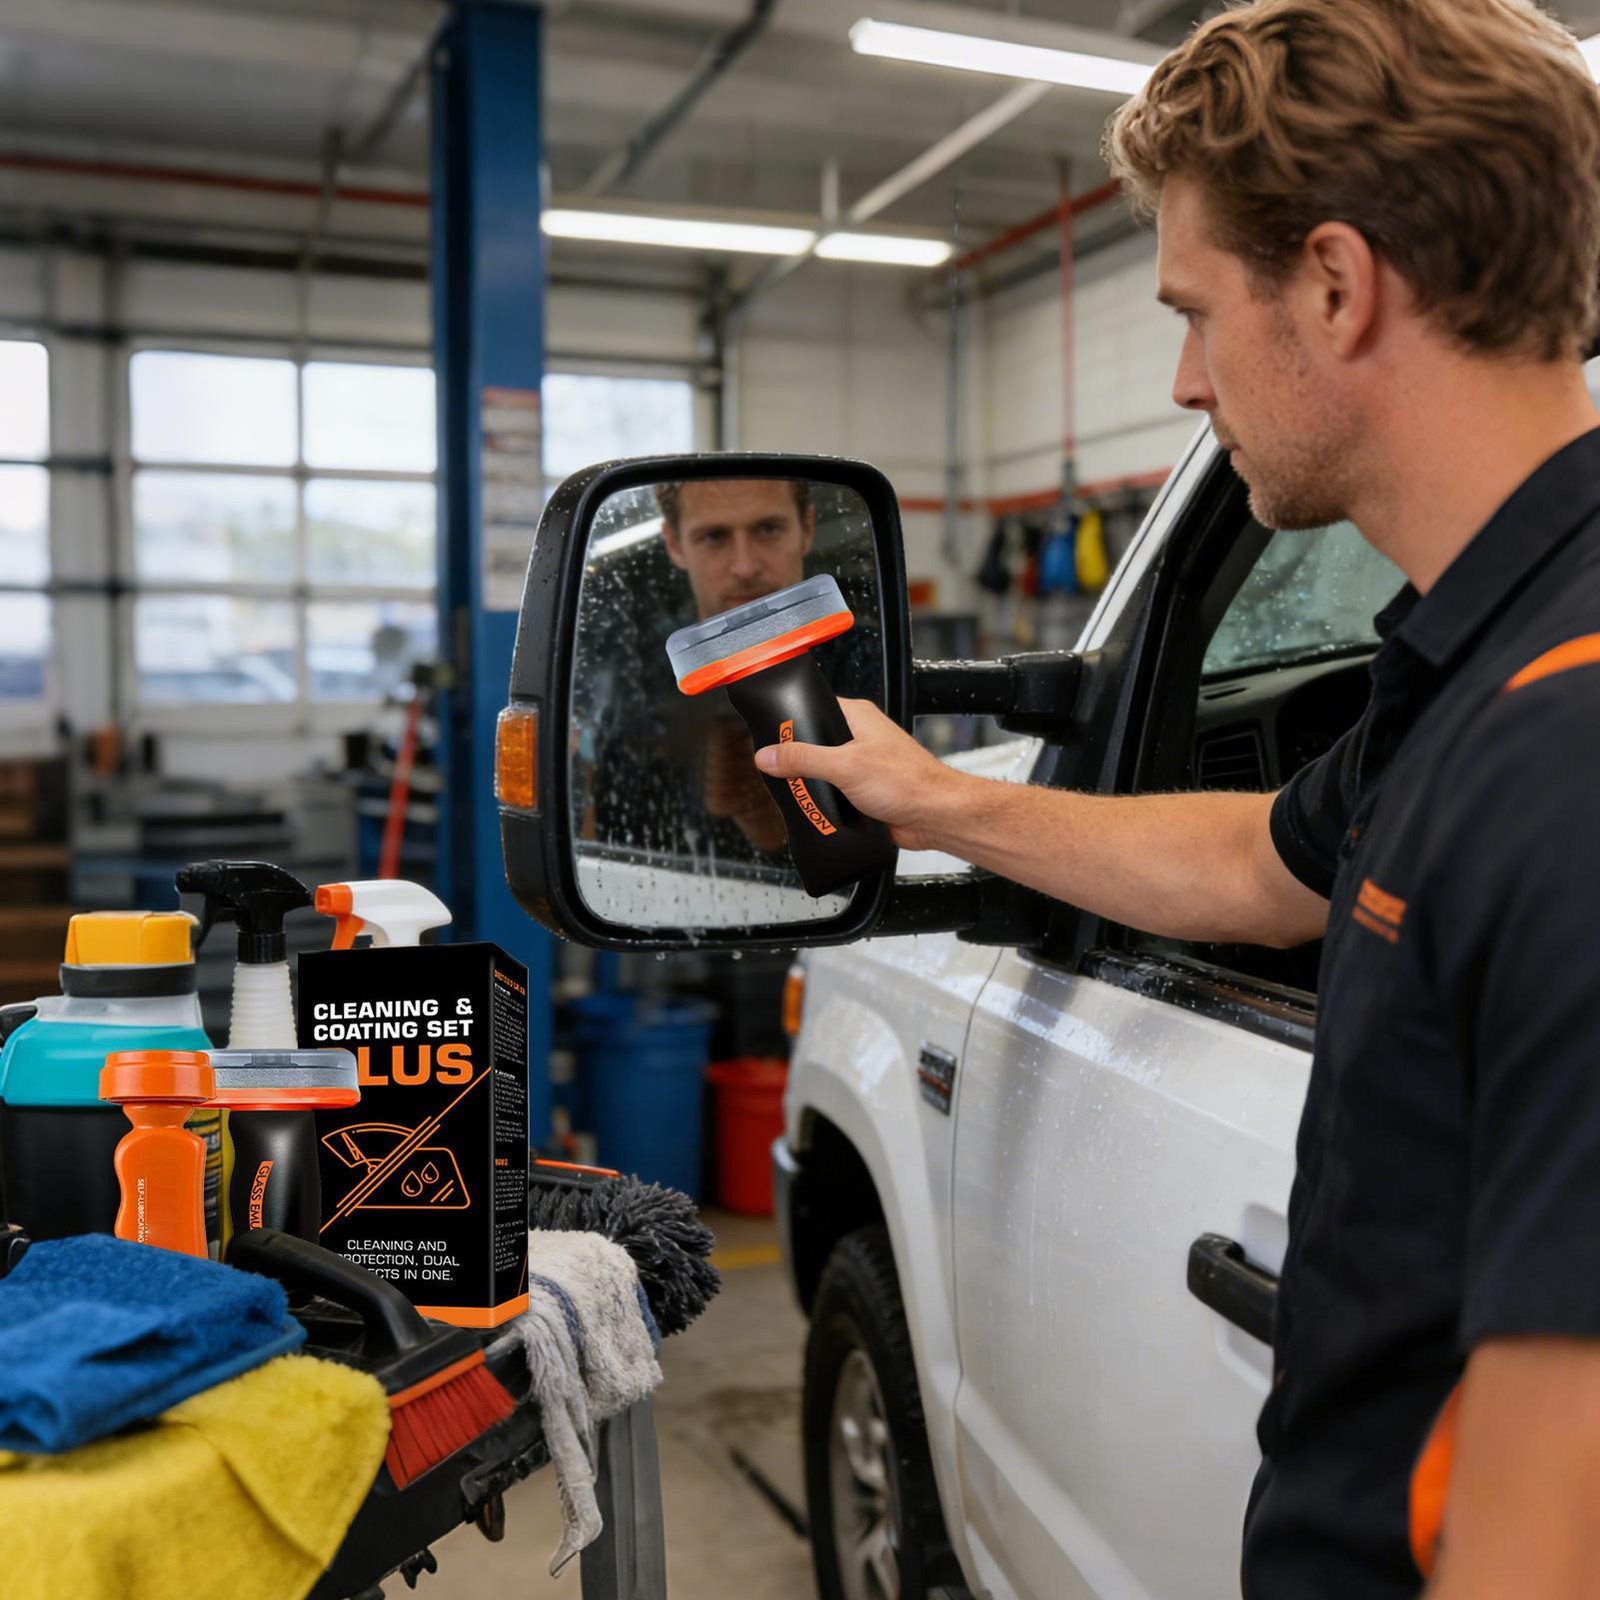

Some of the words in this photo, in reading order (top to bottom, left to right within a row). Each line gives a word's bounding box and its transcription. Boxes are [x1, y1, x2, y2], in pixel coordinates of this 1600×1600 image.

[789, 778, 829, 830] MULSION
[313, 999, 439, 1020] CLEANING
[456, 998, 473, 1015] &
[313, 1021, 418, 1041] COATING
[427, 1019, 473, 1037] SET
[357, 1043, 473, 1086] LUS
[251, 1165, 270, 1201] GLASS
[250, 1204, 260, 1229] EMU
[347, 1239, 413, 1251] CLEANING
[417, 1241, 447, 1252] AND
[338, 1254, 418, 1266] ROTECTION,
[423, 1255, 460, 1266] DUAL
[404, 1269, 417, 1280] IN
[421, 1269, 453, 1281] ONE.
